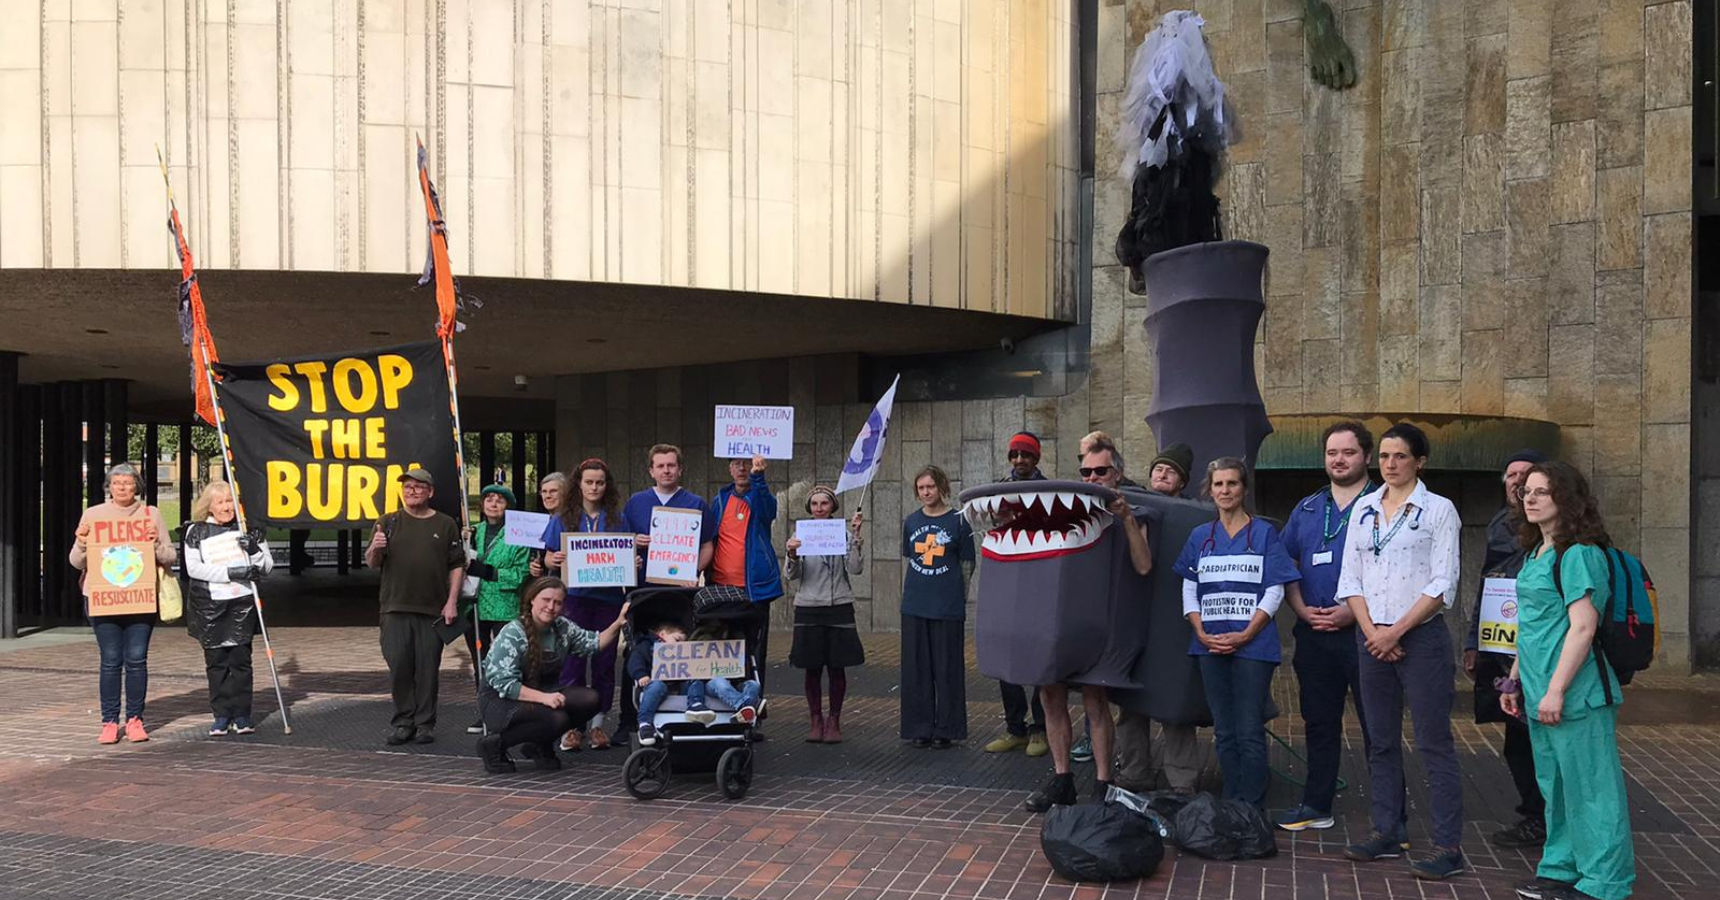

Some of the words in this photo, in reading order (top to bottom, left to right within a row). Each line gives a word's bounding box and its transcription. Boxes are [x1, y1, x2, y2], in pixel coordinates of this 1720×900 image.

[265, 354, 414, 413] STOP
[716, 406, 791, 420] INCINERATION
[725, 424, 747, 437] BAD
[748, 426, 778, 437] NEWS
[303, 417, 386, 459] THE
[727, 441, 771, 455] HEALTH
[94, 519, 152, 543] PLEASE
[570, 538, 634, 551] INCINERATORS
[653, 532, 695, 547] CLIMATE
[586, 552, 616, 564] HARM
[649, 550, 697, 563] EMERGENCY
[577, 566, 626, 583] HEALTH
[92, 588, 155, 606] RESUSCITATE
[1202, 597, 1236, 607] PROTESTING
[1238, 598, 1255, 607] FOR
[1203, 607, 1223, 616] PUBLIC
[1223, 606, 1251, 615] HEALTH
[657, 641, 741, 661] CLEAN
[653, 661, 692, 679] AIR
[710, 661, 743, 676] Health
